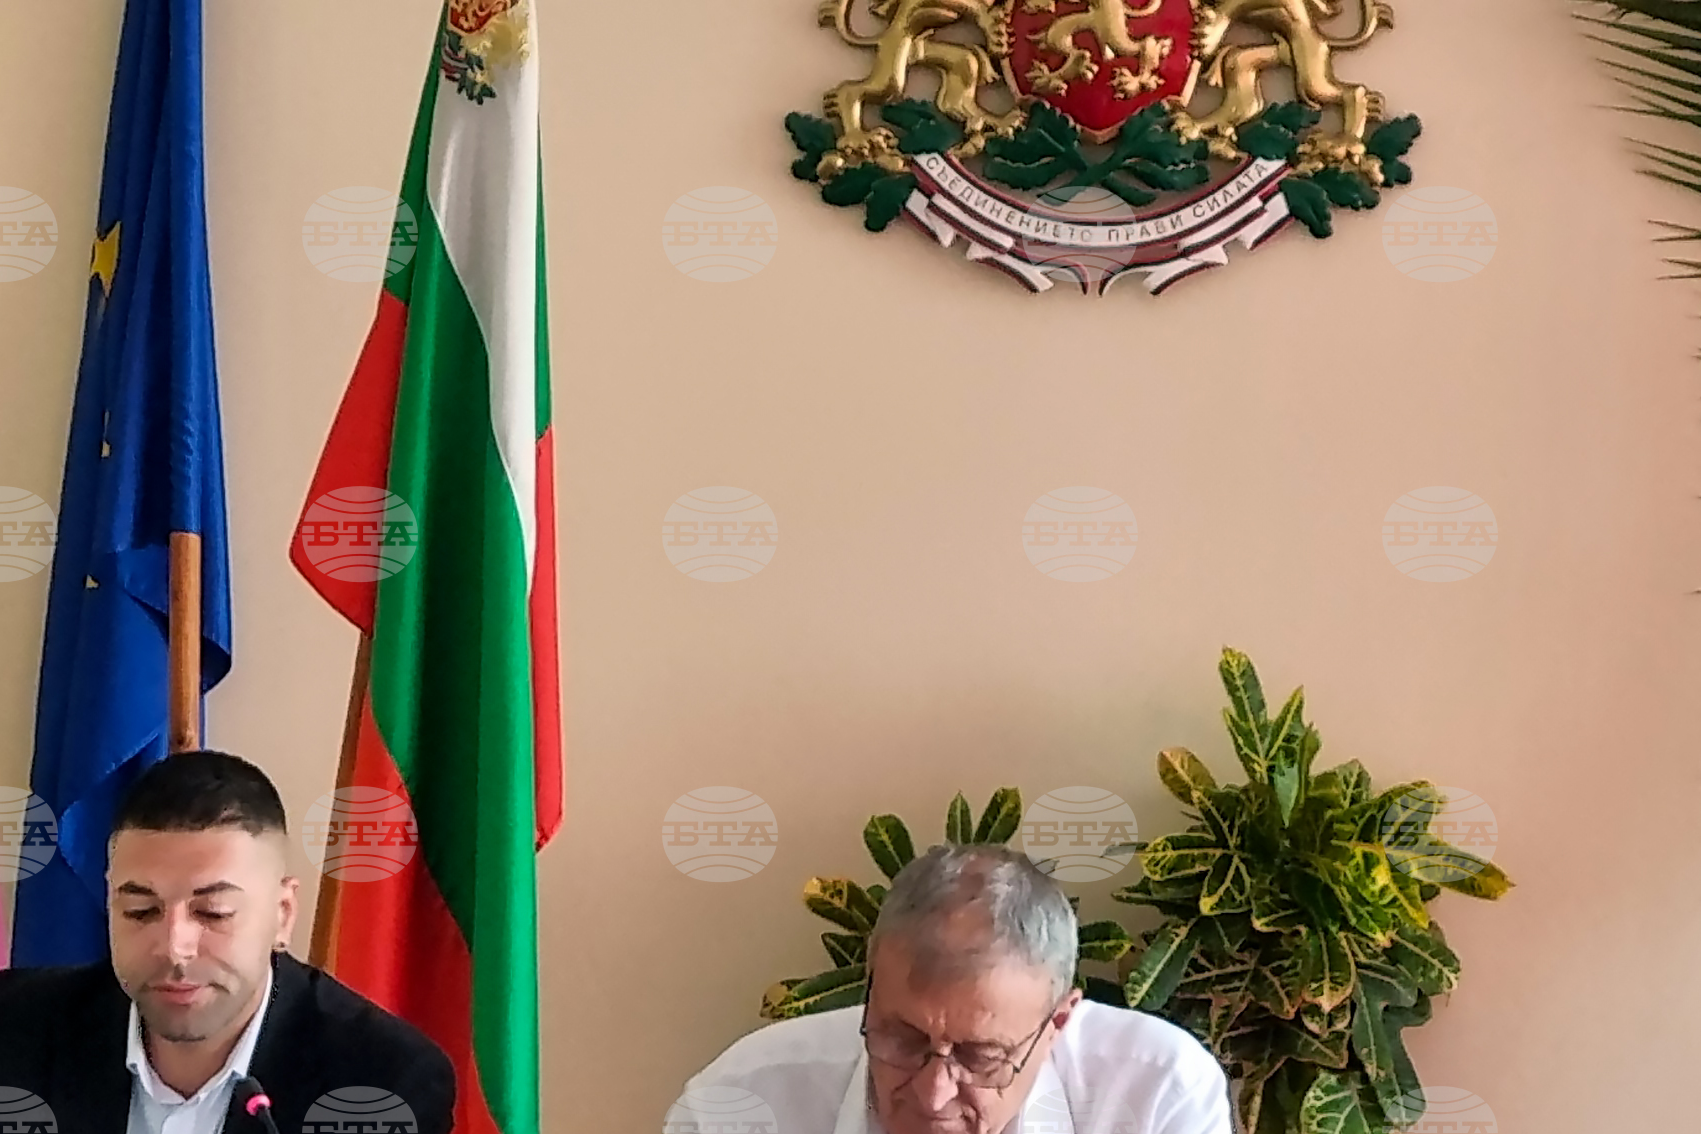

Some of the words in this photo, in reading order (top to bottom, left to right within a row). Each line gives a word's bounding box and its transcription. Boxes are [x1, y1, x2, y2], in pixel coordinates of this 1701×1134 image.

[926, 156, 1093, 243] СЪЕДИНЕНИЕТО
[1107, 214, 1184, 242] ПРАВИ
[1191, 162, 1270, 219] СИЛАТА
